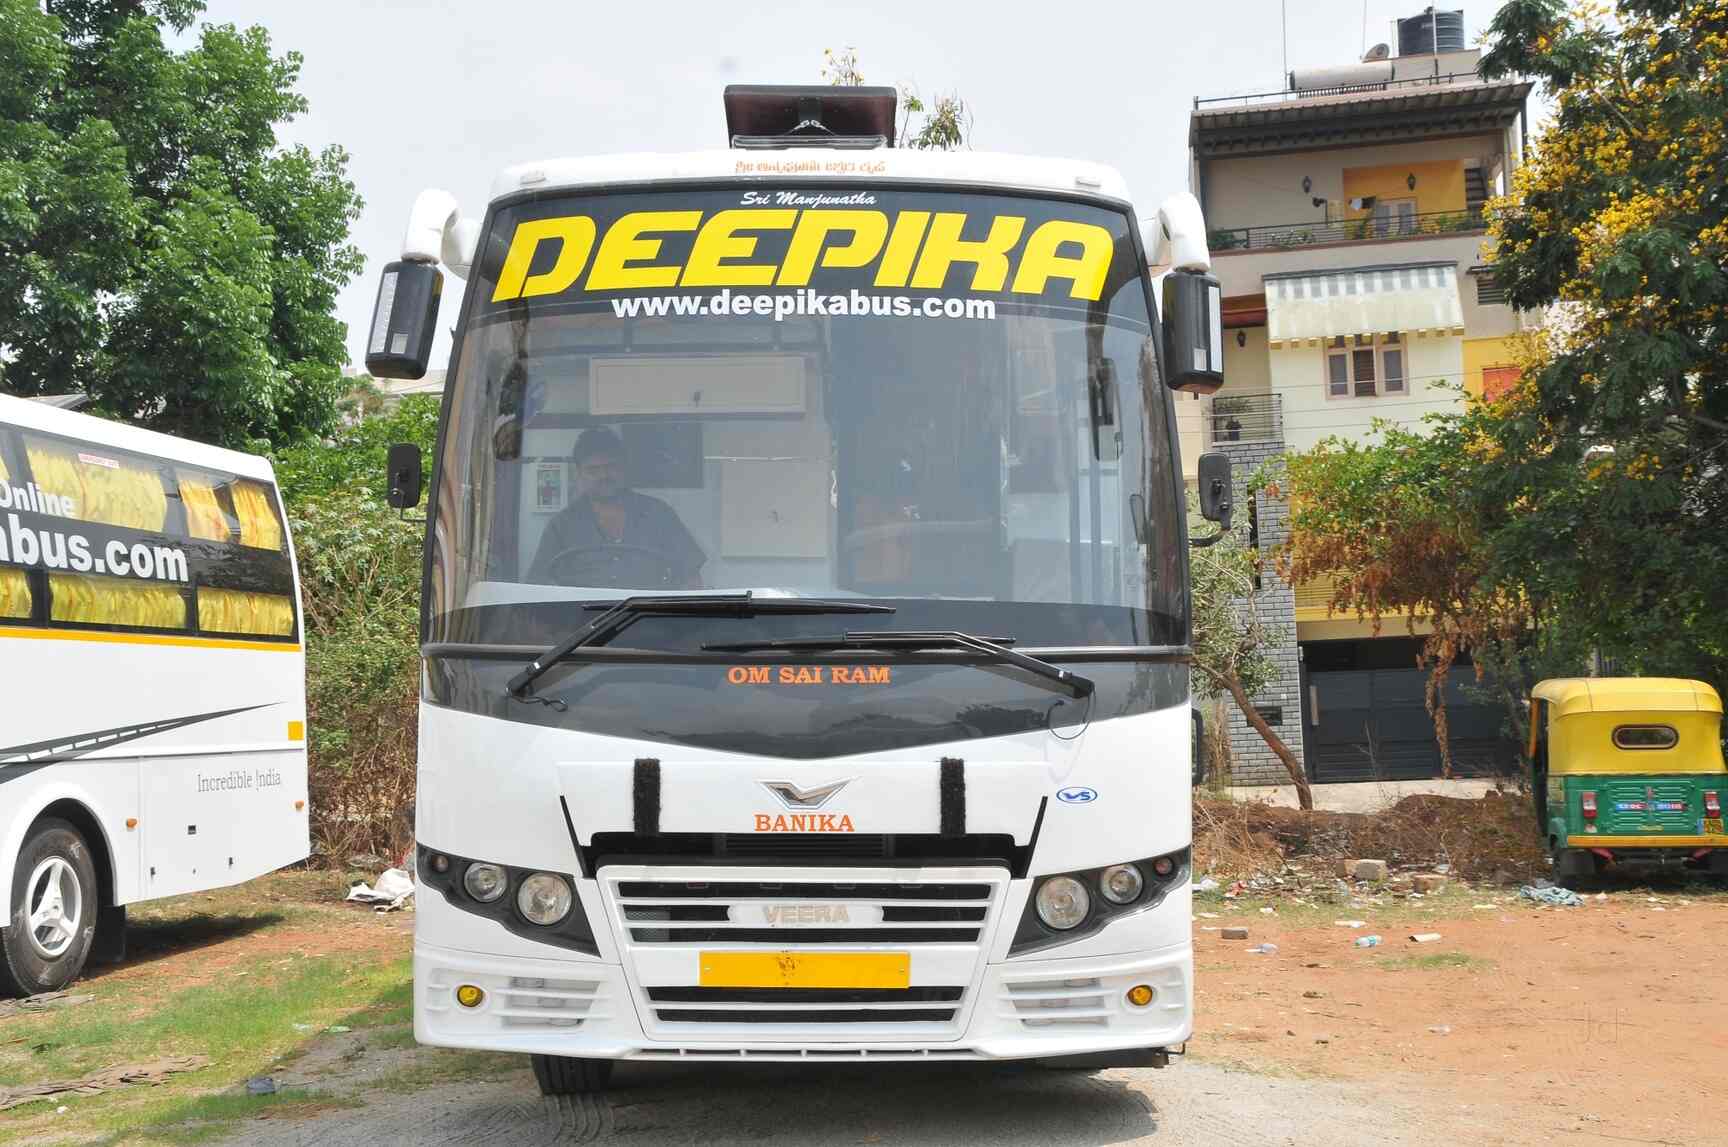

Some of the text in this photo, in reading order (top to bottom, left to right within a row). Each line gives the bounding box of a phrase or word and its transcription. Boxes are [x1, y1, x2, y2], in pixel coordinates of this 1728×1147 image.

[740, 191, 877, 208] Sri Manjunatha
[491, 209, 1114, 303] DEEPIKA
[611, 288, 997, 321] www.deepikabus.com
[728, 666, 891, 684] OM SAI RAM
[198, 770, 253, 792] Incredible
[753, 814, 856, 832] BANIKA
[764, 904, 850, 924] VEERA
